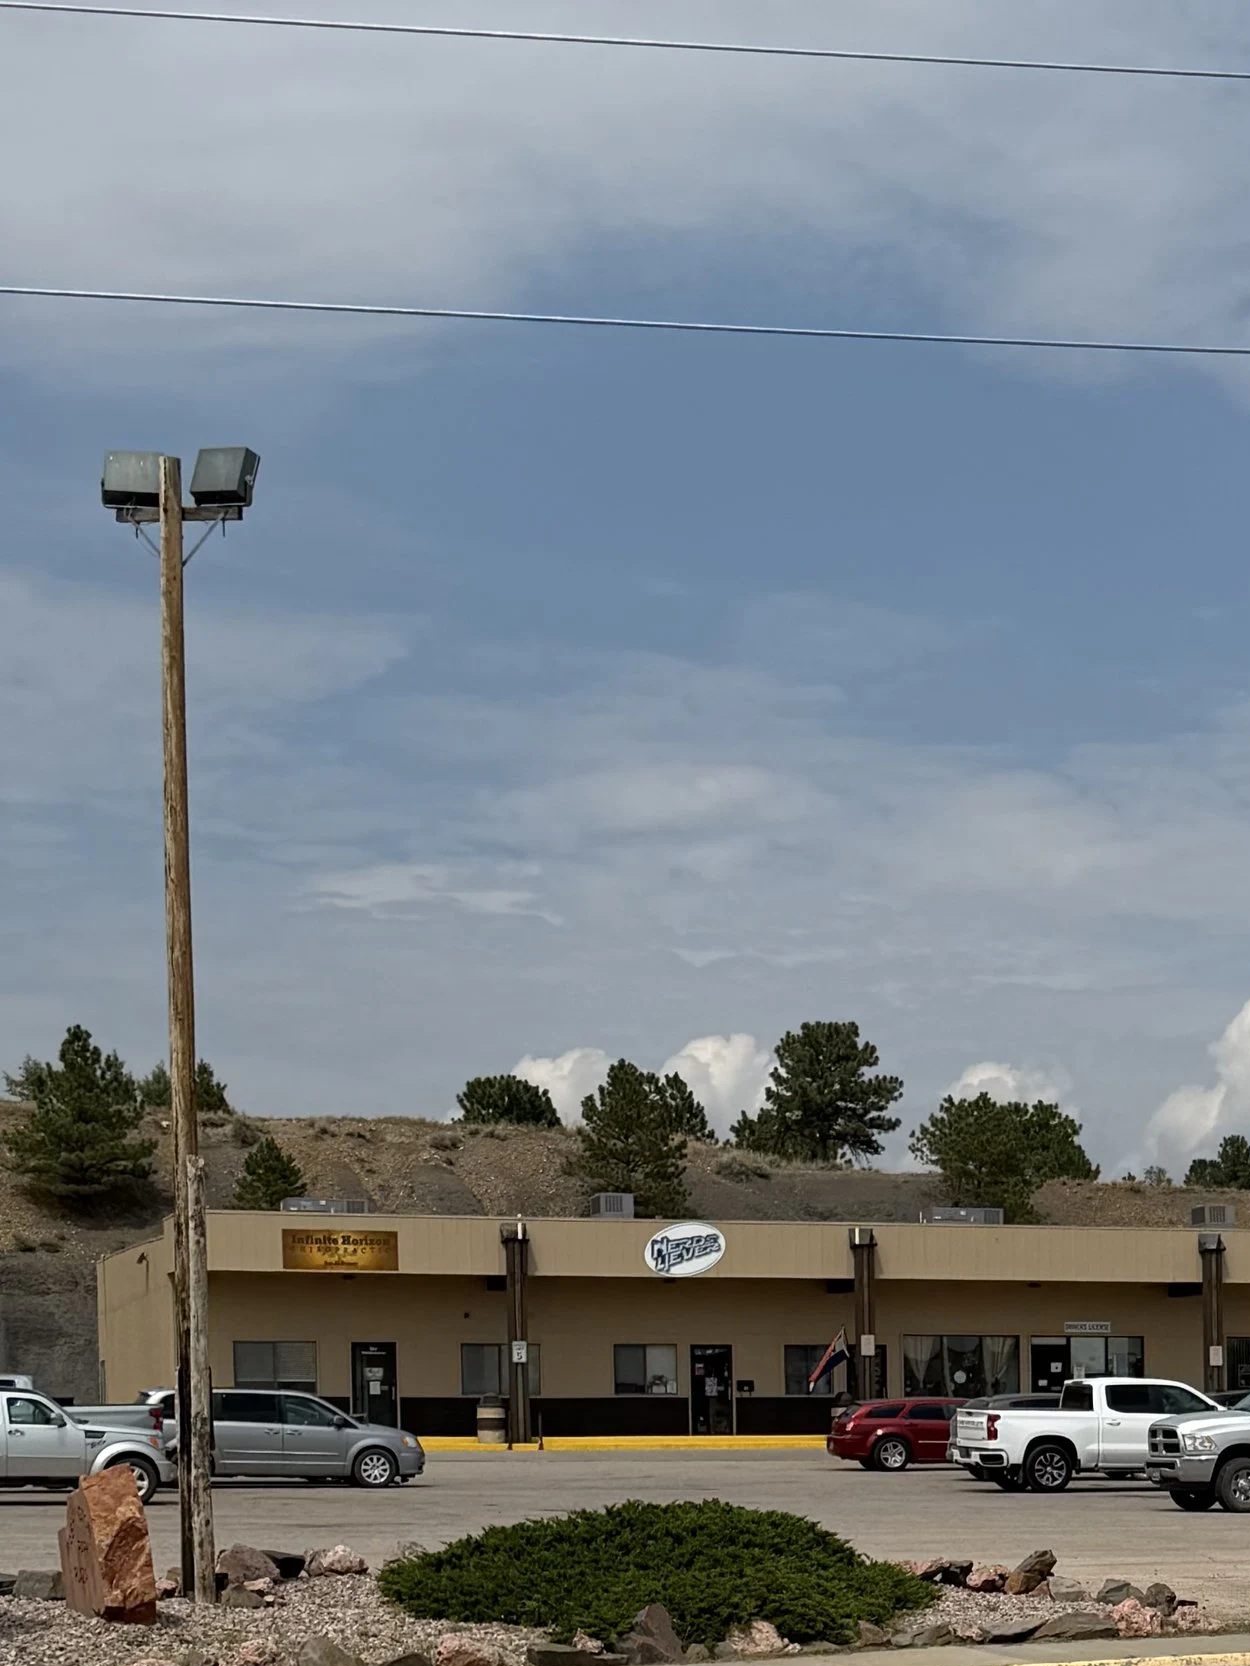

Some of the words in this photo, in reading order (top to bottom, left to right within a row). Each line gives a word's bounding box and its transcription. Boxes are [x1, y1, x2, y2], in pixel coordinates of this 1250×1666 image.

[291, 1233, 339, 1246] Infinite
[341, 1235, 391, 1246] Horizon
[289, 1246, 393, 1254] CHIROPRACTIC
[651, 1234, 720, 1260] NERDS
